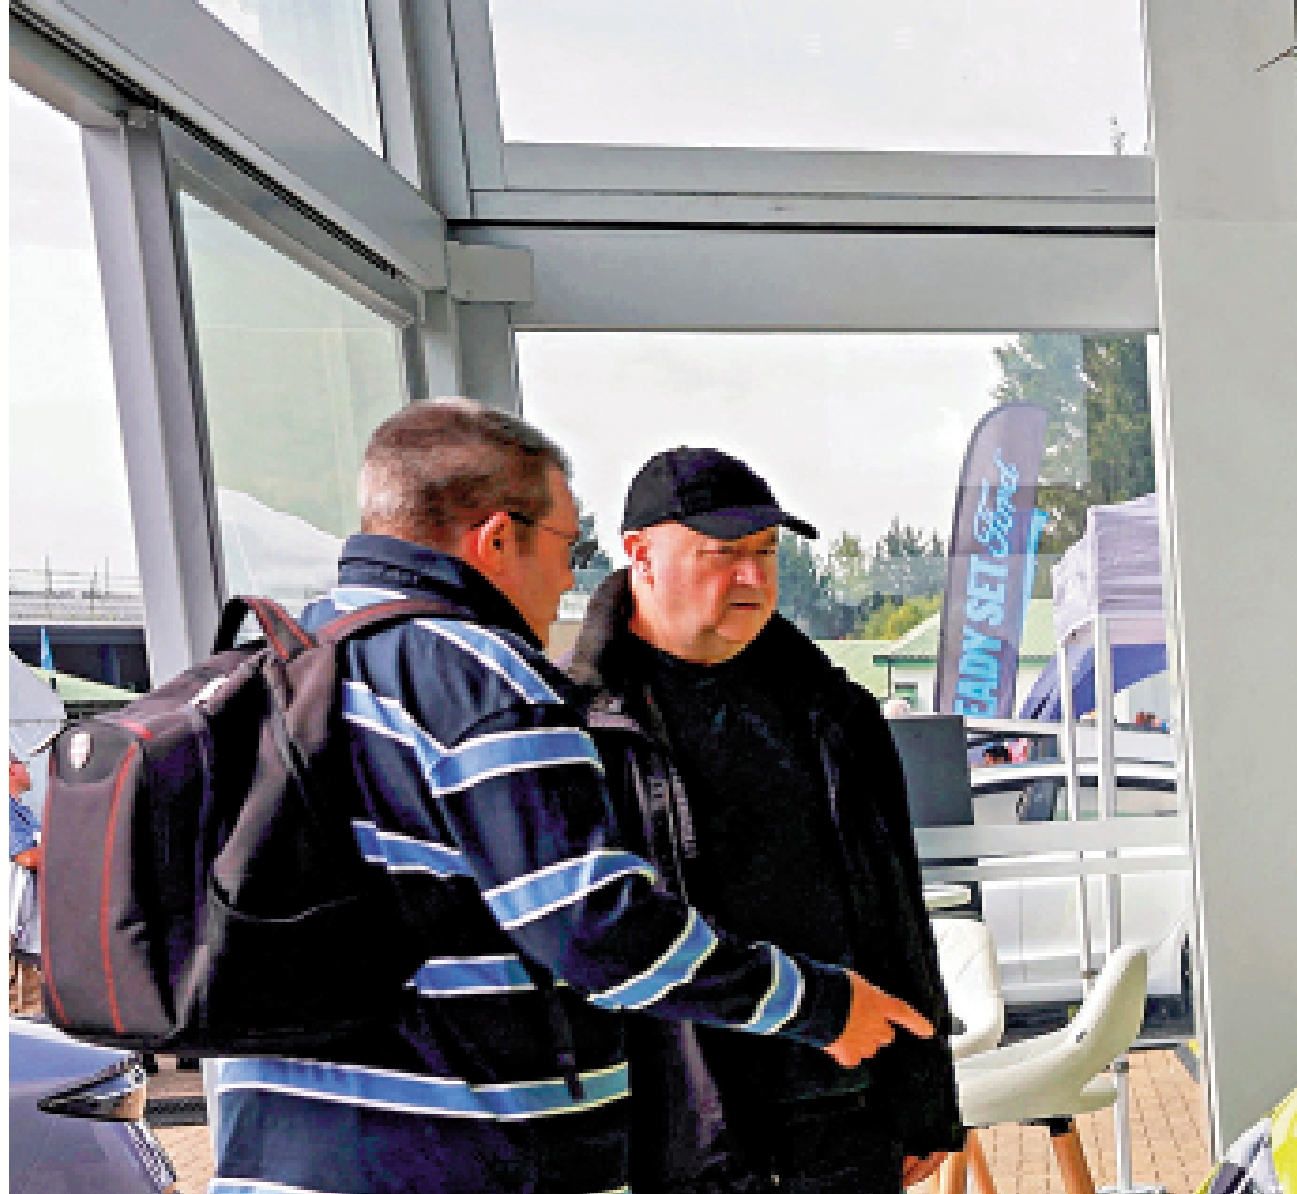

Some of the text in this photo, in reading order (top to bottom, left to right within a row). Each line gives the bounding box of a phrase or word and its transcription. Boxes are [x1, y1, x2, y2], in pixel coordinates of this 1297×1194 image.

[954, 448, 1021, 718] EADY SET Ford
